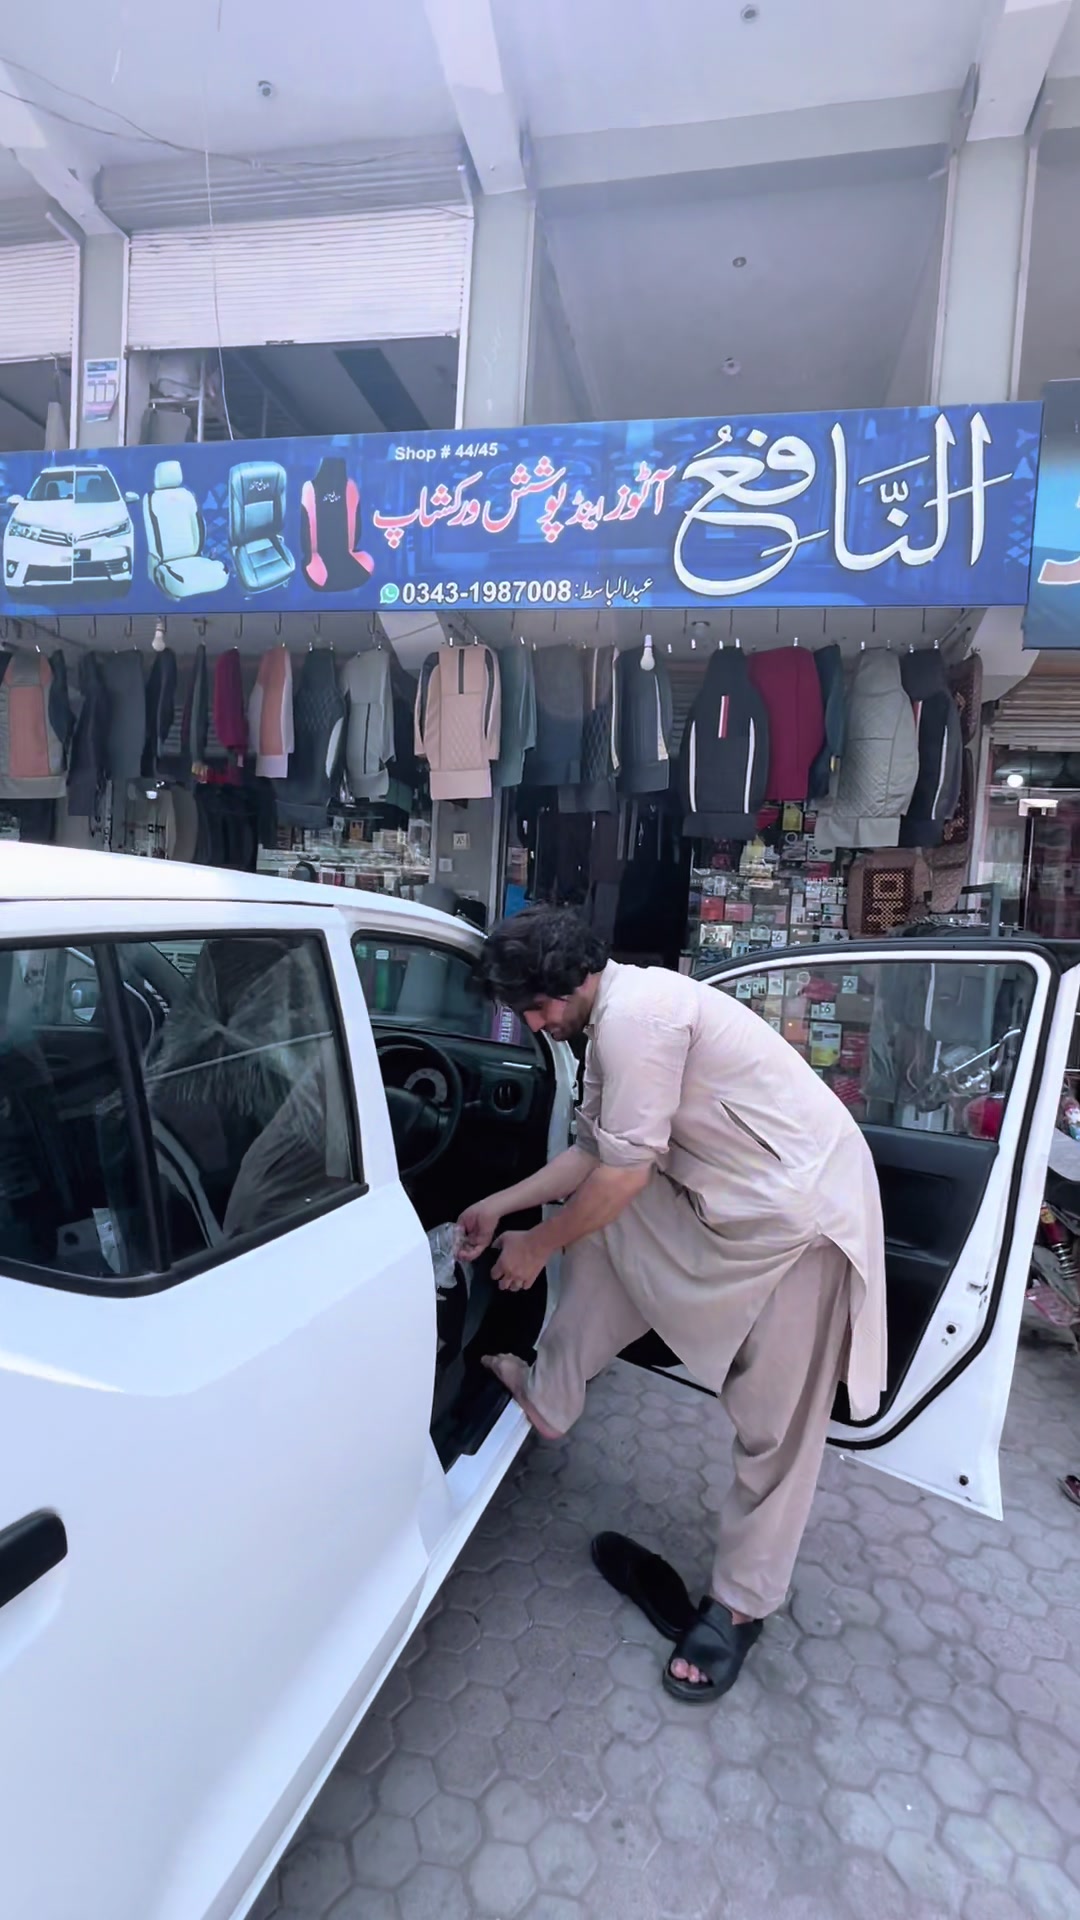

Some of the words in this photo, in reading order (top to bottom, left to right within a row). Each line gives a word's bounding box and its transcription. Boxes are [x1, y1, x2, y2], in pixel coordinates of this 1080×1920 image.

[394, 446, 437, 462] Shop
[440, 444, 451, 459] #
[454, 442, 498, 458] 44/45
[373, 471, 483, 549] ورکشاپ
[482, 455, 567, 543] پوشش
[603, 461, 677, 521] آٹوز
[402, 579, 572, 605] 0343-1987008
